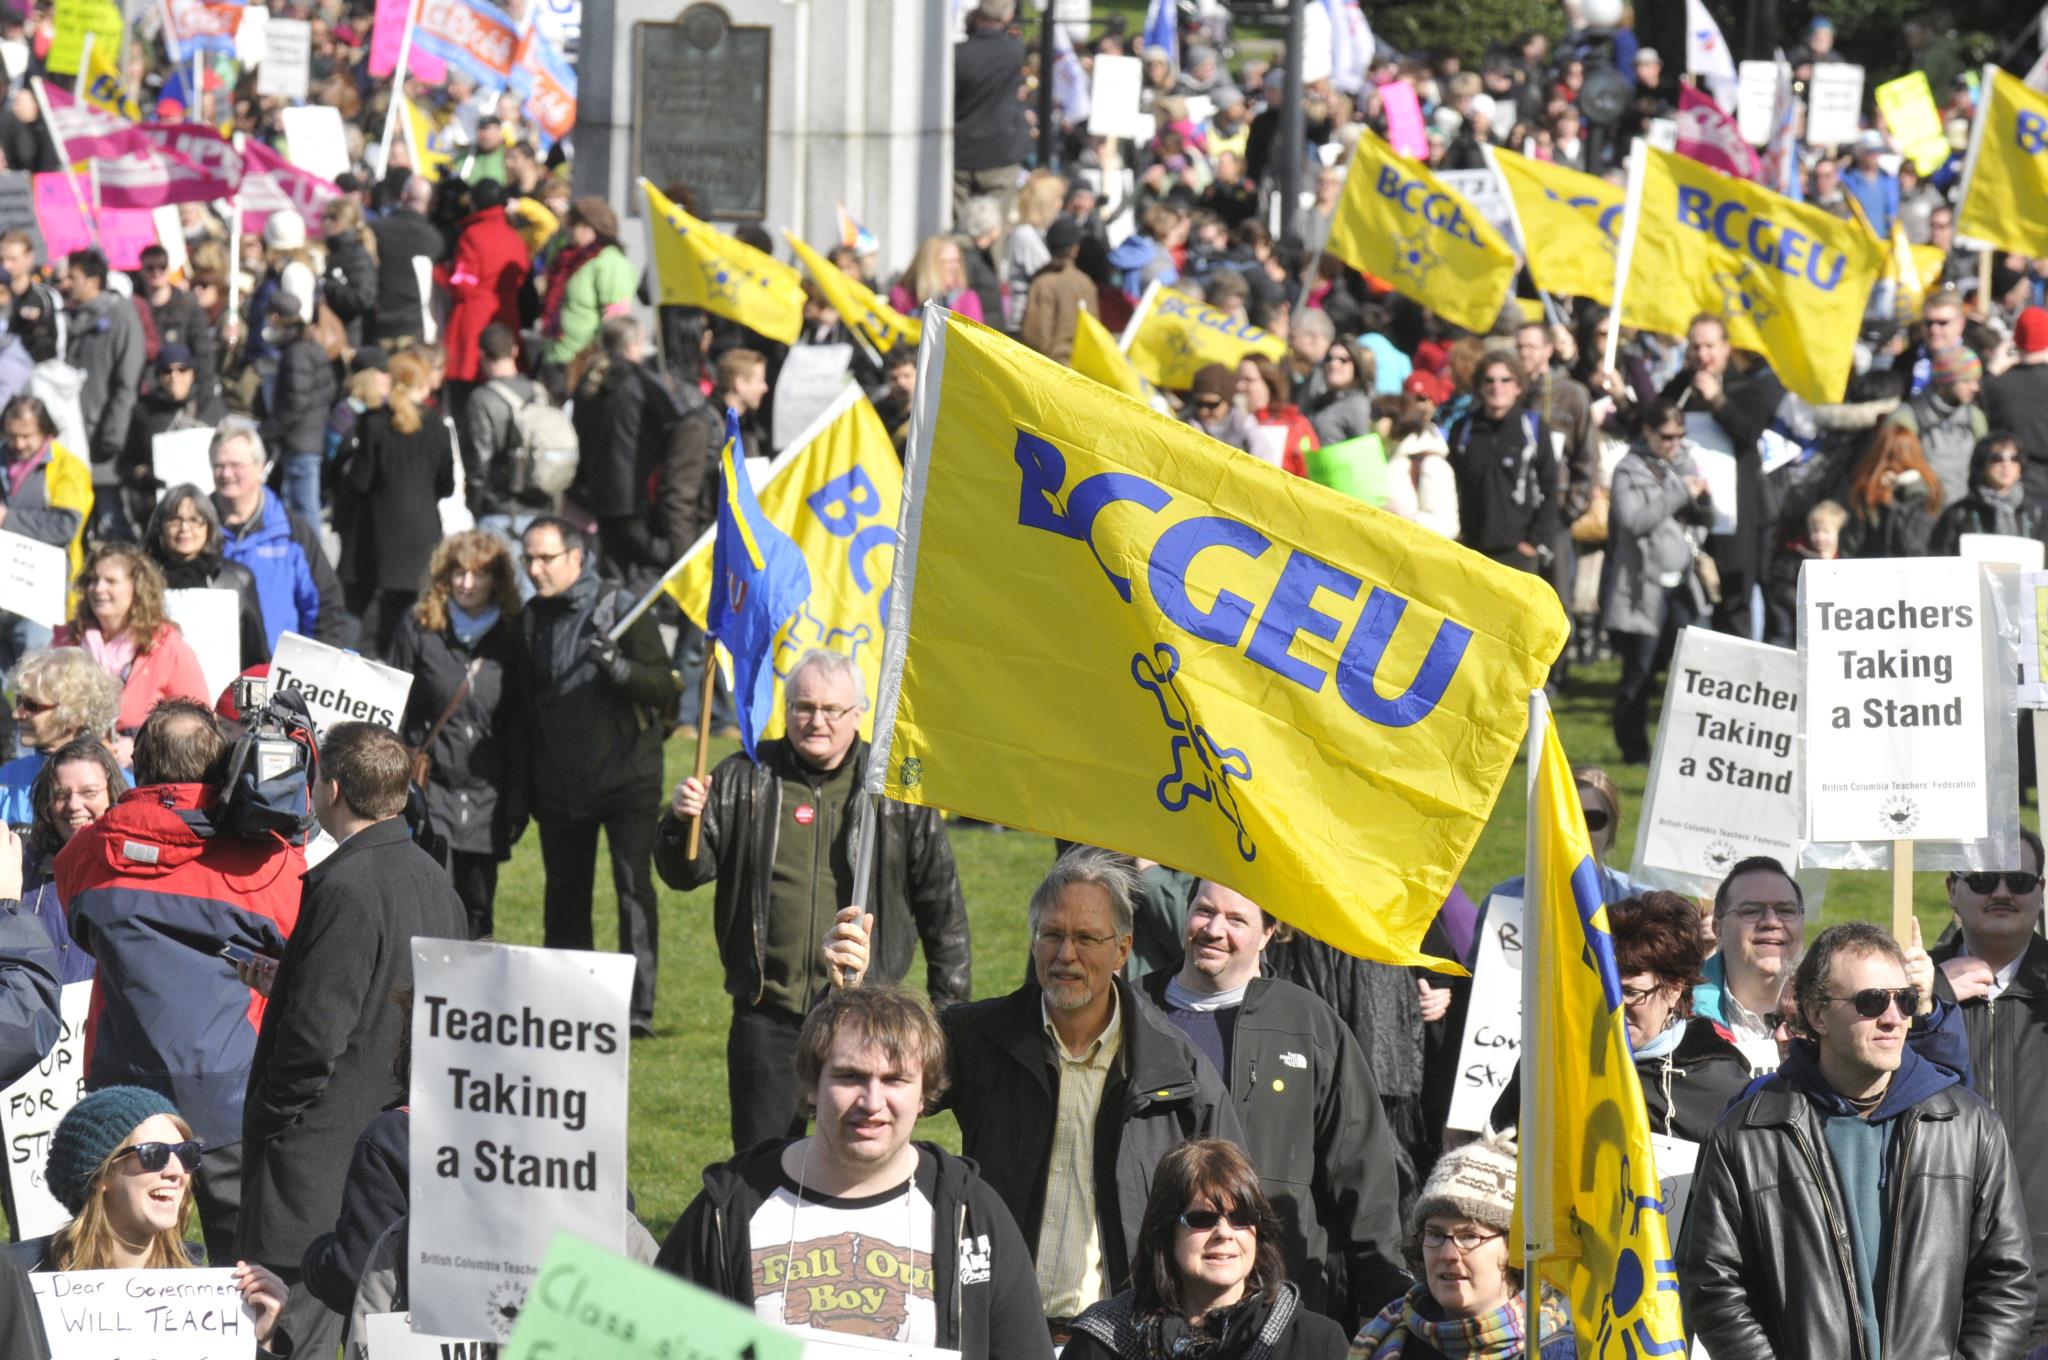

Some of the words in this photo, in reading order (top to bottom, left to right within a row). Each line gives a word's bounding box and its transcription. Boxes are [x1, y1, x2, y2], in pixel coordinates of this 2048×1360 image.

[1677, 184, 1846, 291] BCGEU
[1014, 427, 1473, 728] BCGEU
[1815, 600, 1974, 632] Teachers
[1837, 648, 1953, 684] Taking
[1831, 705, 1851, 729] a
[1863, 696, 1962, 729] Stand
[1695, 712, 1792, 758] Taking
[1679, 756, 1697, 777] a
[1706, 757, 1793, 796] Stand
[1822, 782, 1848, 792] British
[1850, 783, 1889, 792] Columbia
[1932, 780, 1976, 790] Federation
[1659, 817, 1682, 829] British
[1683, 822, 1717, 836] Columbia
[1753, 834, 1791, 849] Federation
[424, 995, 617, 1055] Teachers
[10, 1090, 59, 1119] FOR
[448, 1067, 587, 1132] Taking
[436, 1145, 459, 1179] a
[473, 1140, 597, 1192] Stand
[420, 1251, 452, 1267] British
[454, 1256, 500, 1273] Columbia
[761, 1247, 842, 1286] Fall
[52, 1274, 105, 1298] Dear
[806, 1282, 886, 1315] Boy
[60, 1306, 132, 1333] WILL
[144, 1305, 240, 1337] TEACH
